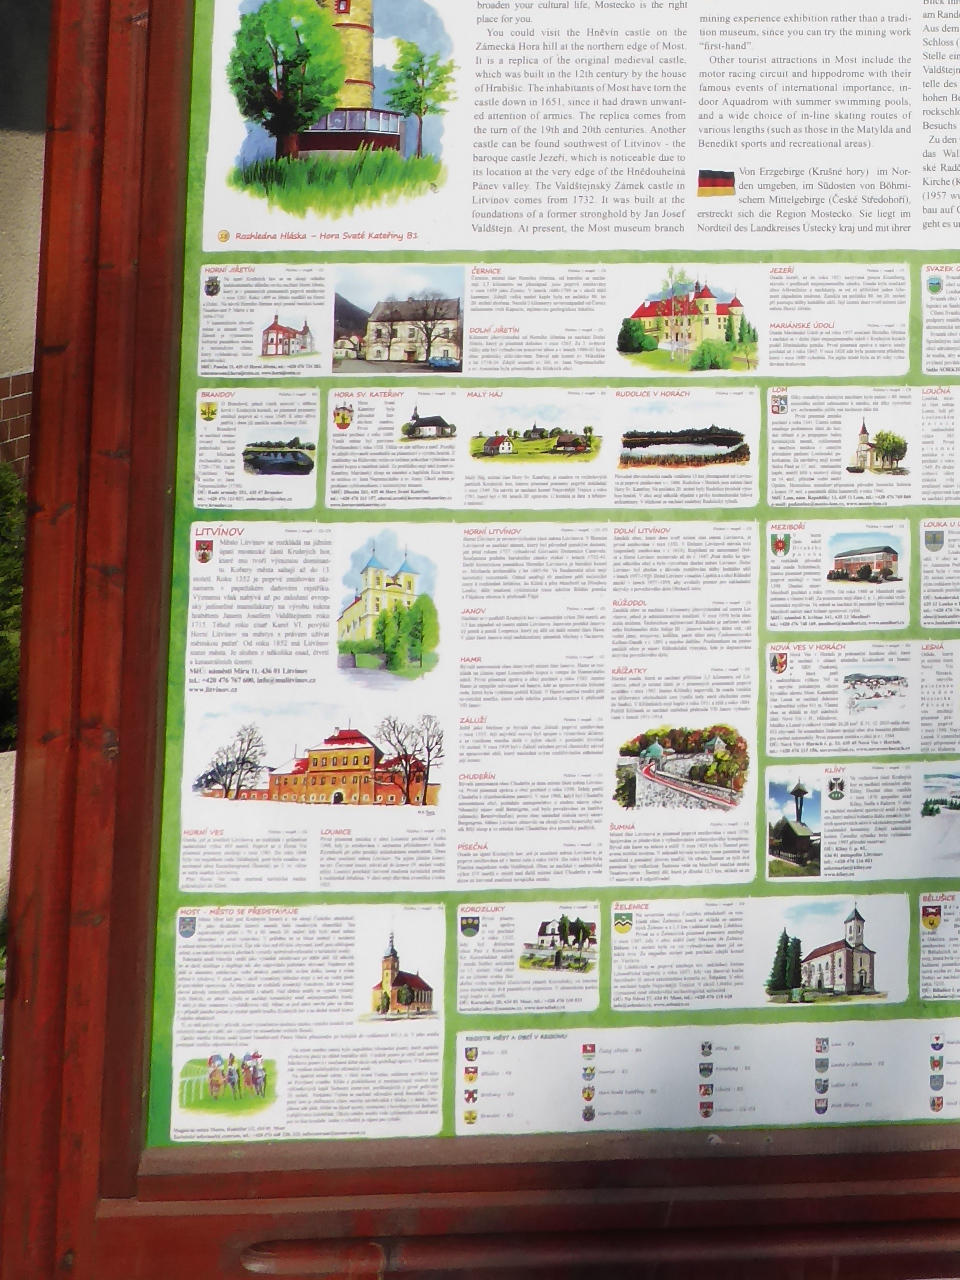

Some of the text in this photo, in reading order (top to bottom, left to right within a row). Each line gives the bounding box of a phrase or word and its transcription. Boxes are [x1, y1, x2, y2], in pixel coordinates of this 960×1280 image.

[235, 231, 277, 240] Rozhledna
[280, 231, 307, 240] Hláska
[319, 232, 340, 240] Hora
[342, 231, 365, 240] Svaté
[368, 231, 404, 242] Kateřiny
[406, 231, 418, 240] B1
[204, 265, 255, 274] HORNÍ JIŘETÍN
[471, 266, 501, 275] ČERNICE
[769, 266, 794, 274] JEZEŘÍ
[469, 325, 520, 334] DOLNÍ JIŘETÍN
[769, 321, 835, 329] MARIÁNSKÉ ÚDOLÍ
[369, 389, 404, 398] KATEŘINY
[466, 390, 503, 398] MALÝ HÁJ
[615, 390, 650, 398] RUDOLICE
[772, 386, 788, 394] LOM
[922, 386, 951, 395] LOUČNÁ
[195, 524, 245, 537] LITVÍNOV
[463, 526, 522, 536] HORNÍ LITVÍNOV
[614, 526, 671, 535] DOLNÍ LITVÍNOV
[770, 522, 805, 531] MEZIBOŘÍ
[612, 598, 647, 607] RŮŽODOL
[770, 642, 791, 651] NOVÁ
[459, 715, 487, 724] ZÁLUŽÍ
[824, 765, 846, 774] KLÍNY
[609, 822, 636, 831] ŠUMNÁ
[614, 902, 650, 910] ŽELENICE
